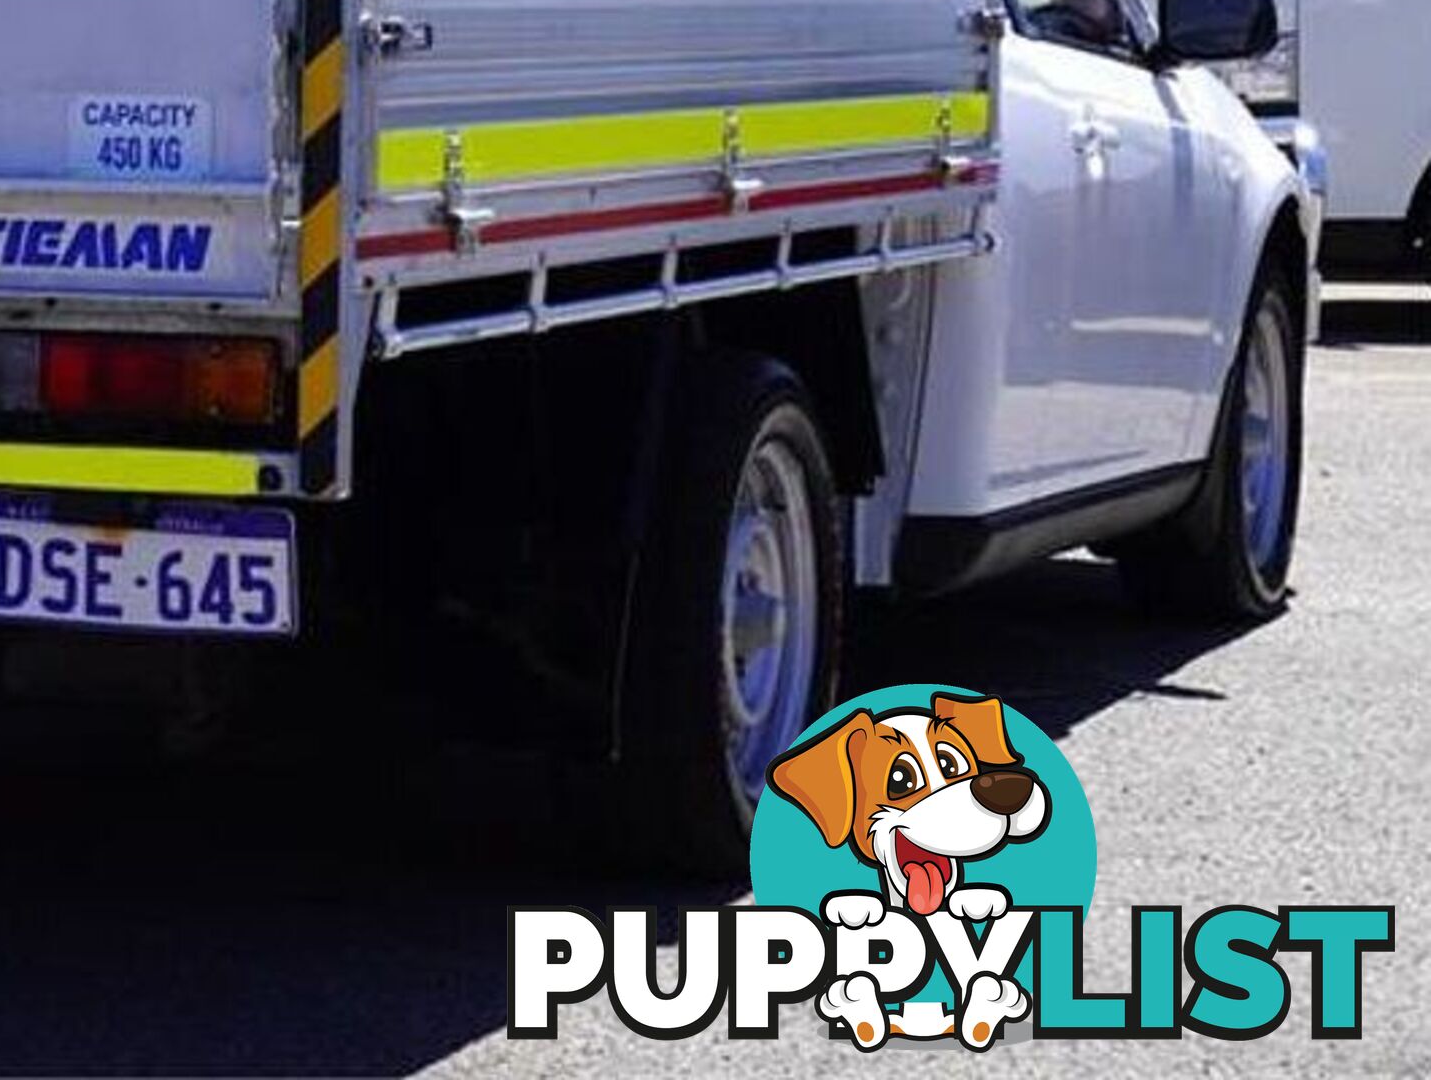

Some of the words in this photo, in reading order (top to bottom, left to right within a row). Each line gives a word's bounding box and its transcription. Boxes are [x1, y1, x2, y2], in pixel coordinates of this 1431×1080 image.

[82, 101, 198, 127] CAPACITY
[96, 135, 142, 170] 450
[147, 136, 183, 171] KG
